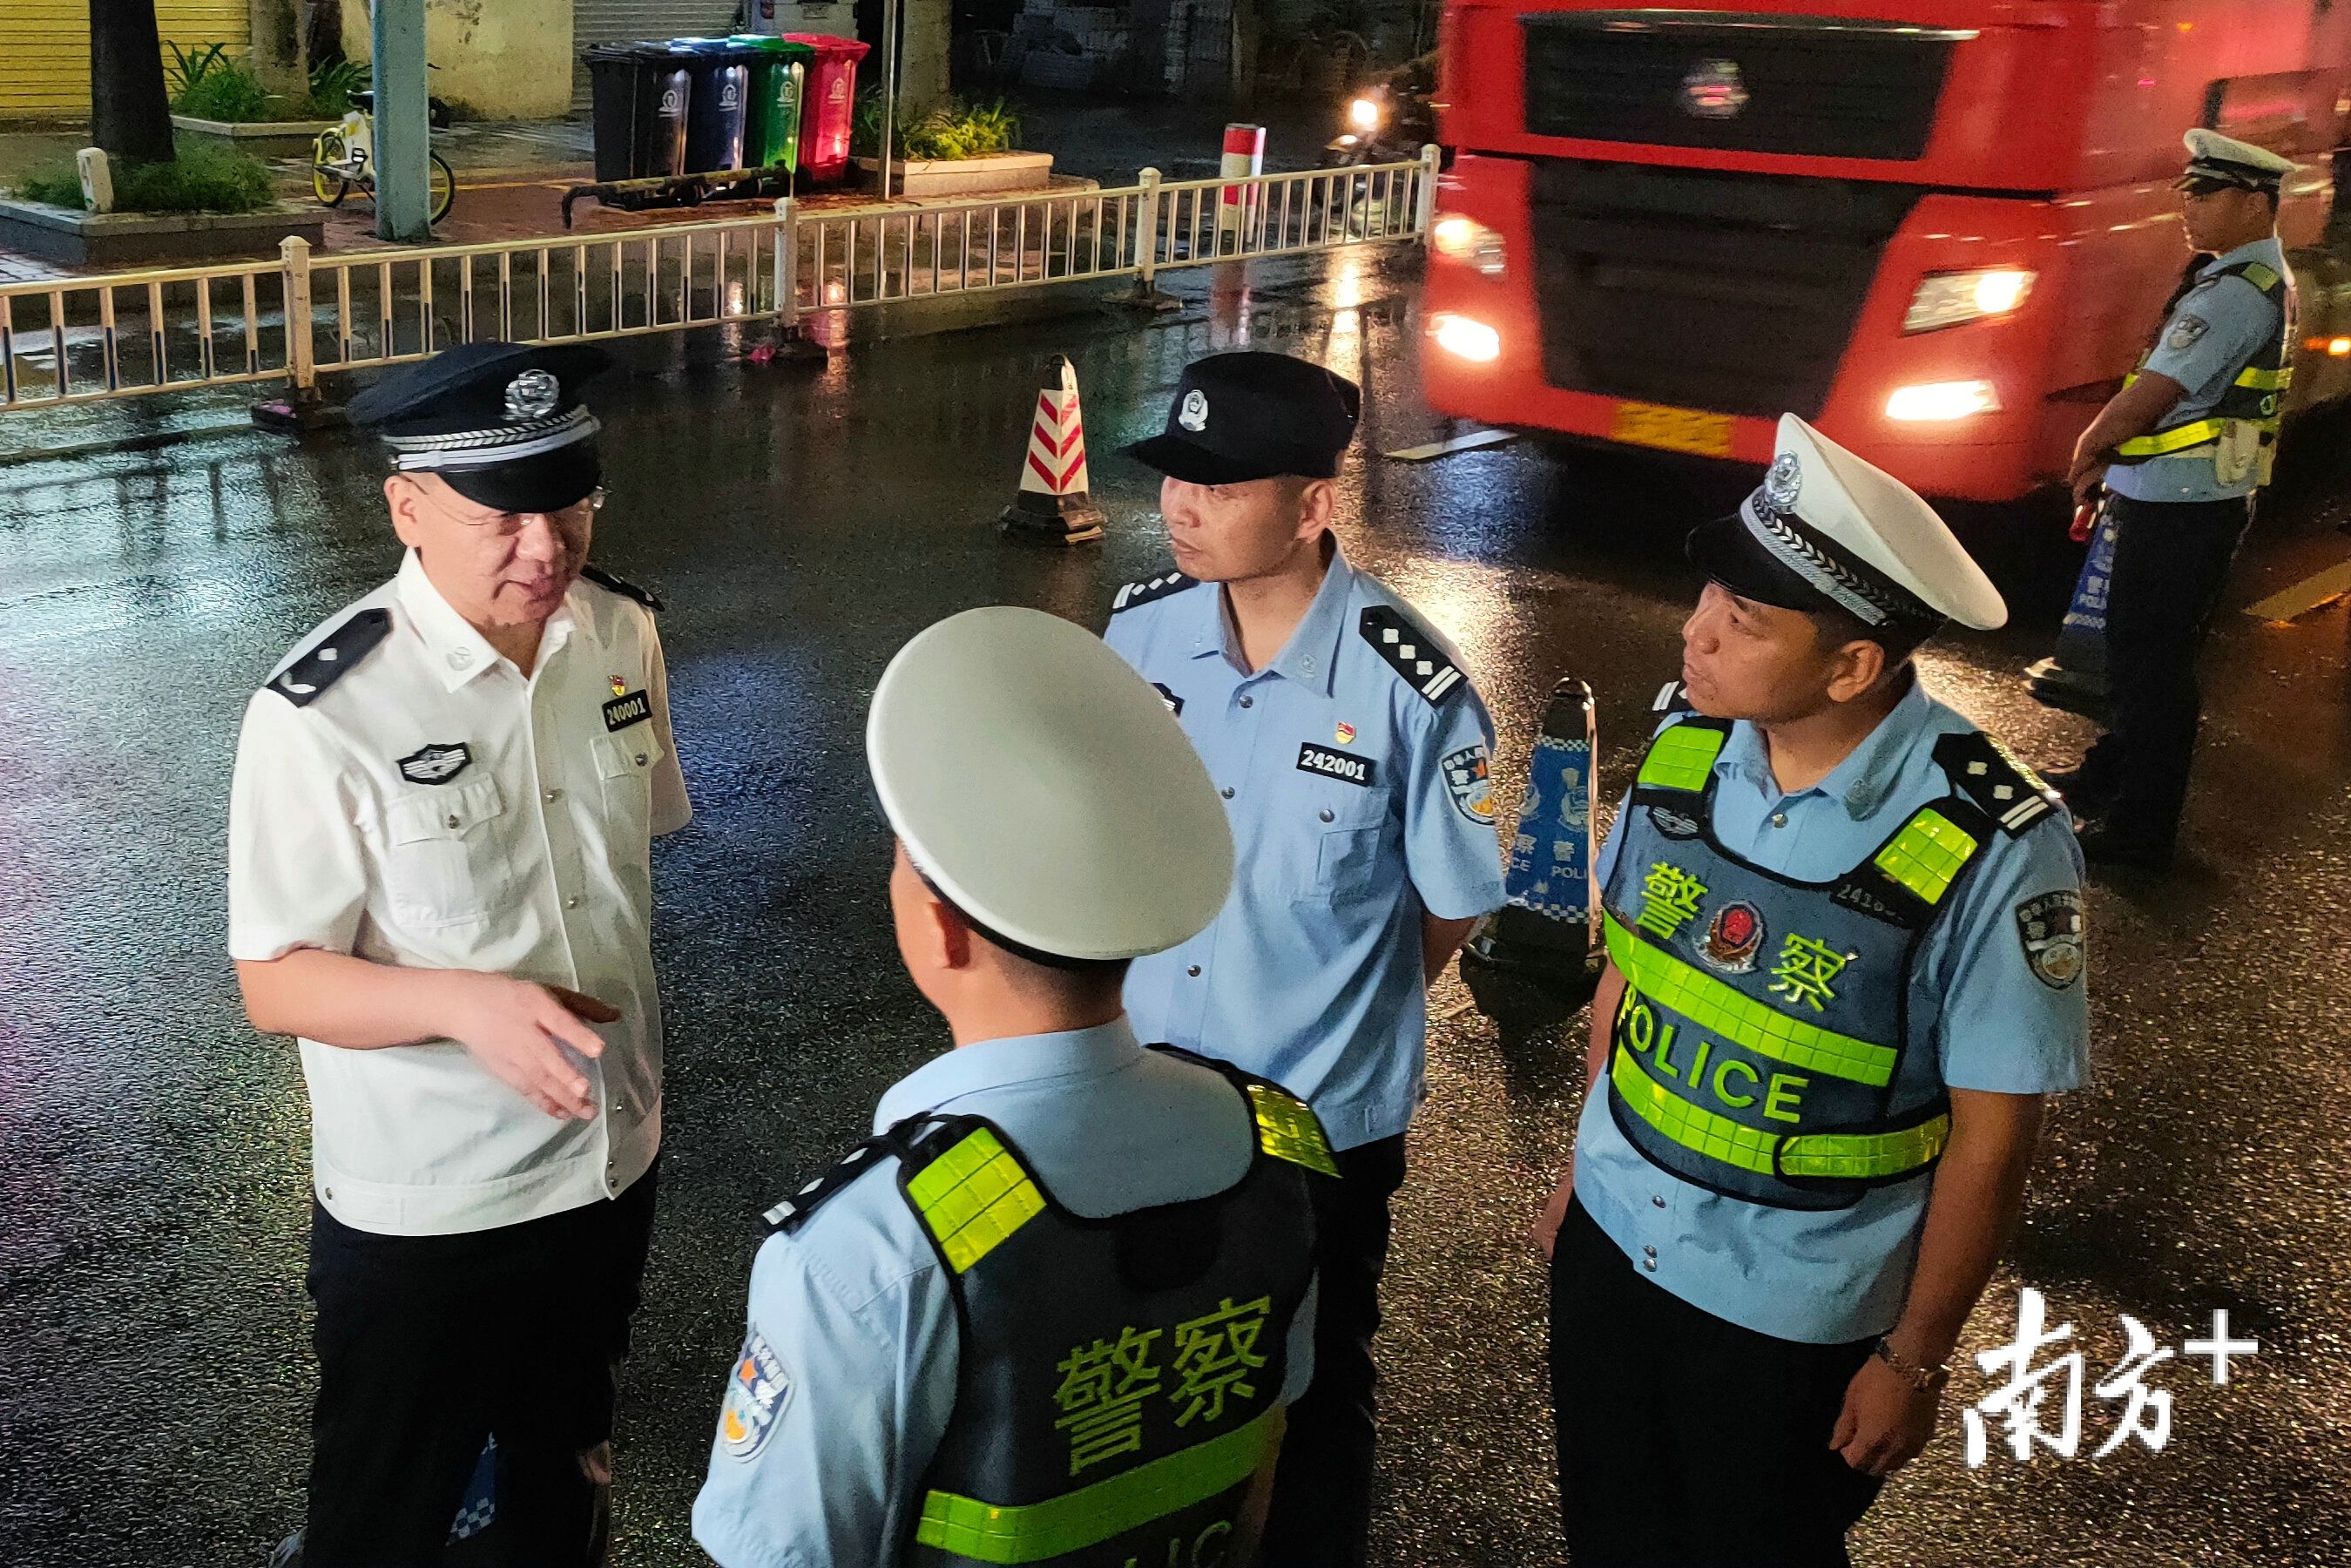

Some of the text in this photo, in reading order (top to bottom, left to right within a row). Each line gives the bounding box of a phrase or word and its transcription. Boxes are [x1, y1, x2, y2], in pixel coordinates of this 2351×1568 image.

[1300, 748, 1367, 781] 242001
[1617, 983, 1810, 1124] POLICE
[1054, 1294, 1271, 1477] 警察
